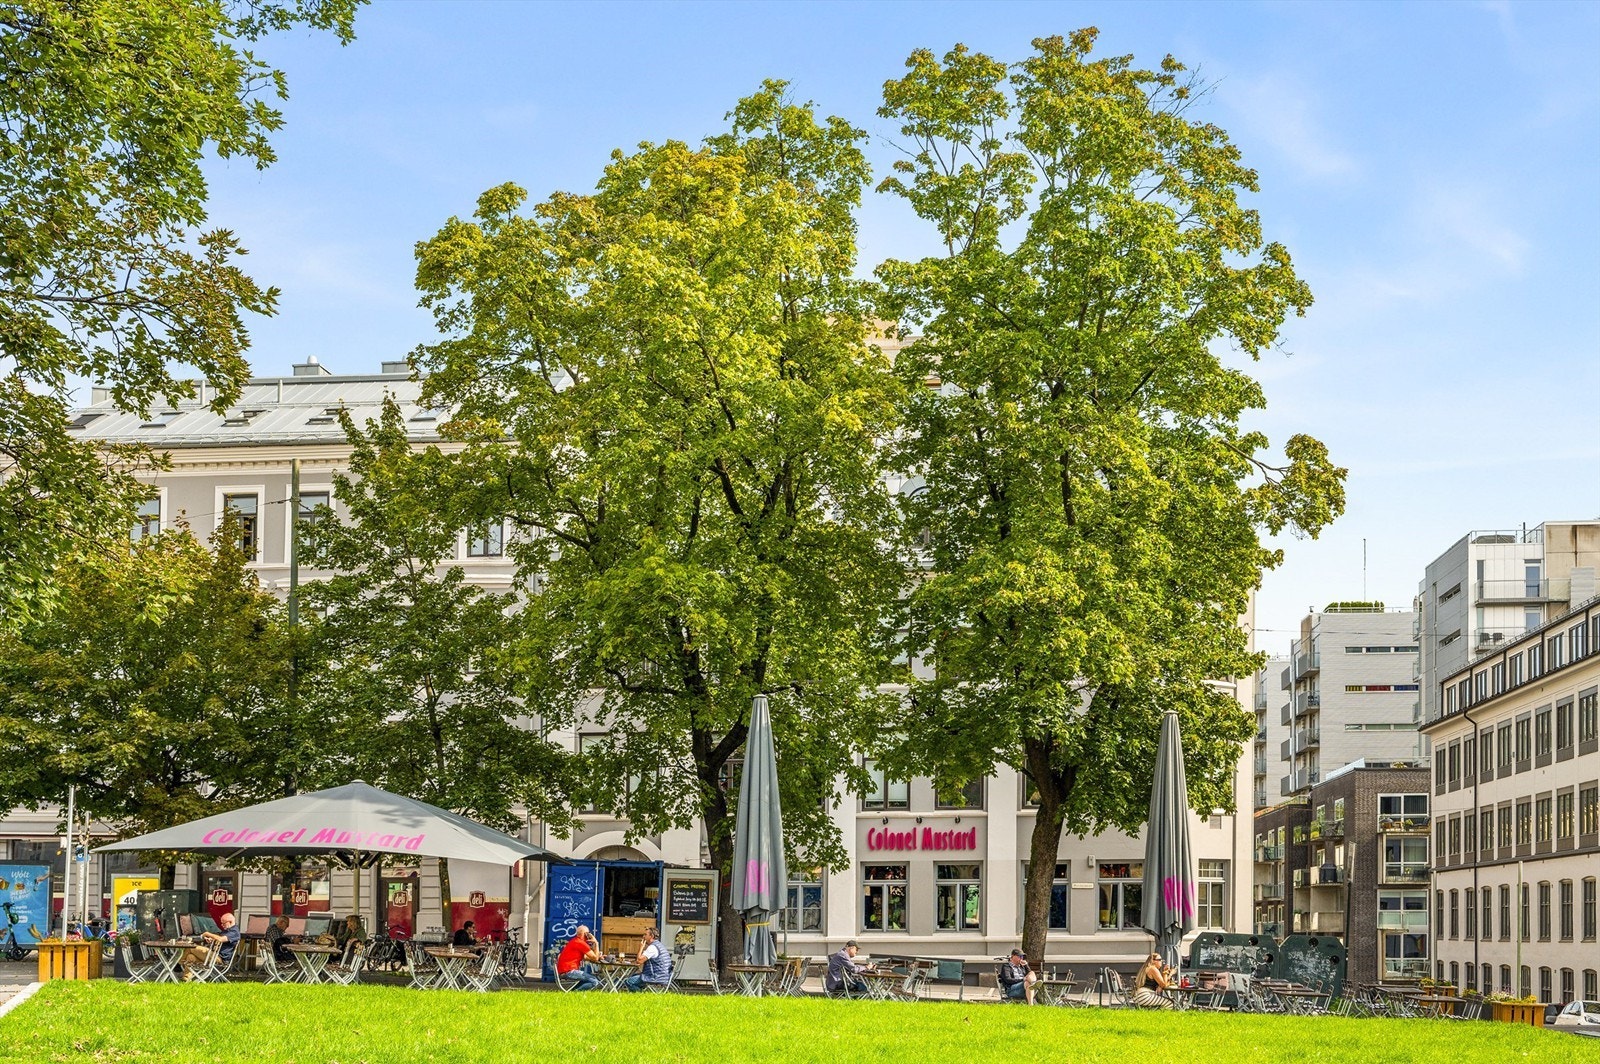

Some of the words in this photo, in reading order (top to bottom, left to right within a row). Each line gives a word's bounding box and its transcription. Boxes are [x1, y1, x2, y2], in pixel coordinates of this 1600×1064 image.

[202, 828, 307, 844] Colonel
[308, 828, 426, 850] Mustard
[867, 827, 917, 850] Colonel
[921, 826, 976, 850] Mustard
[214, 892, 226, 903] deli
[295, 892, 306, 903] deli
[394, 894, 406, 904] deli
[471, 894, 483, 905] deli
